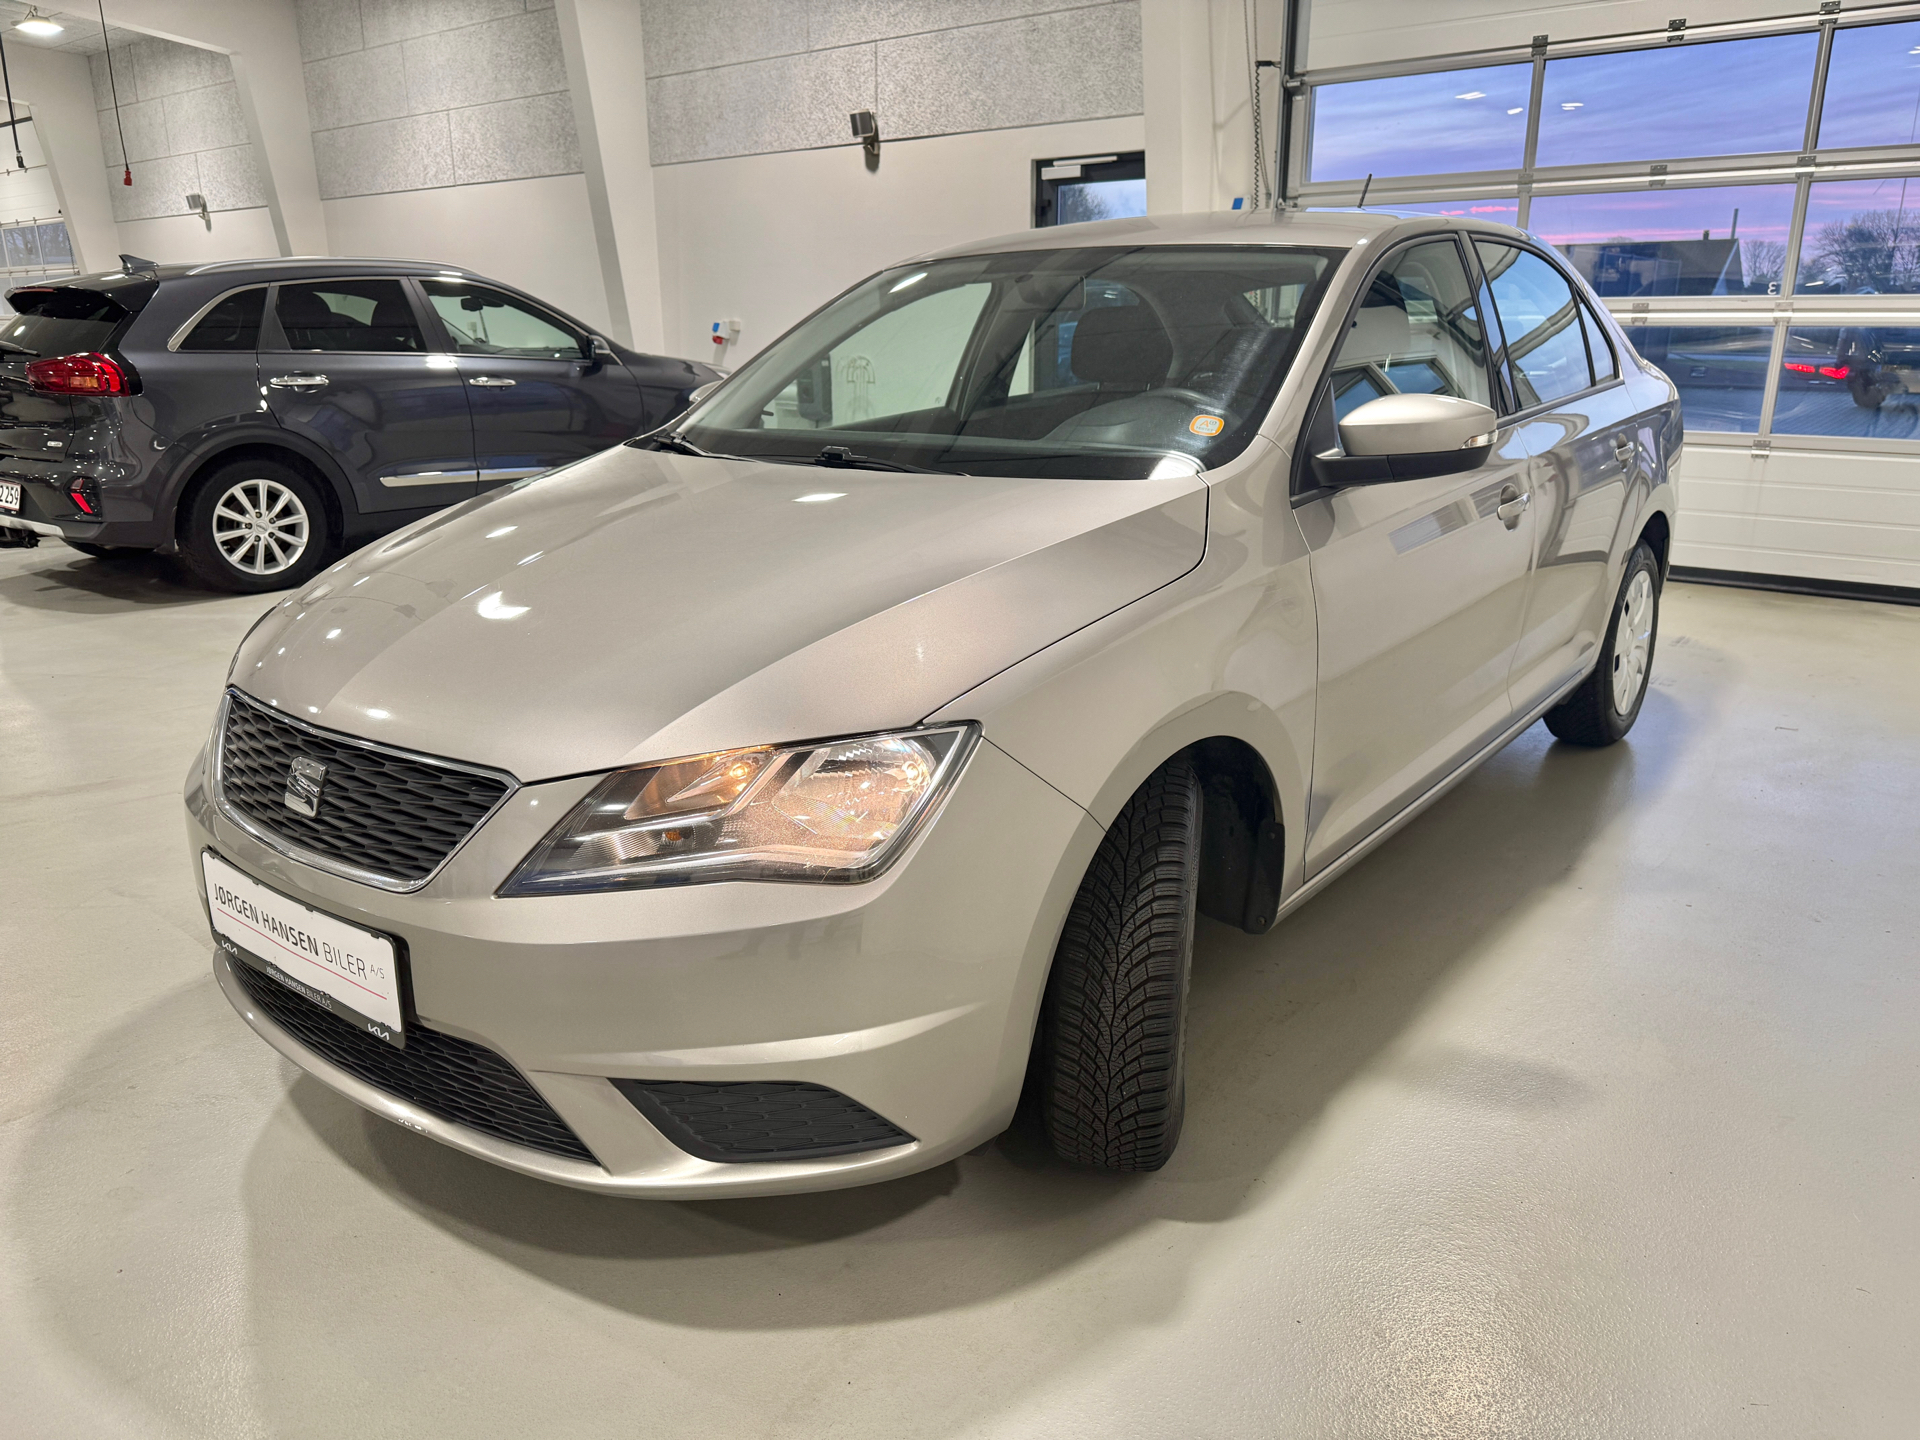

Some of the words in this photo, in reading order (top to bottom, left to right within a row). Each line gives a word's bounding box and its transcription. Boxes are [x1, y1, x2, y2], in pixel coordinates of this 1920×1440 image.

[214, 883, 259, 925] JØRGEN
[261, 910, 319, 957] HANSEN
[322, 941, 368, 980] BILER
[370, 964, 385, 980] A/S
